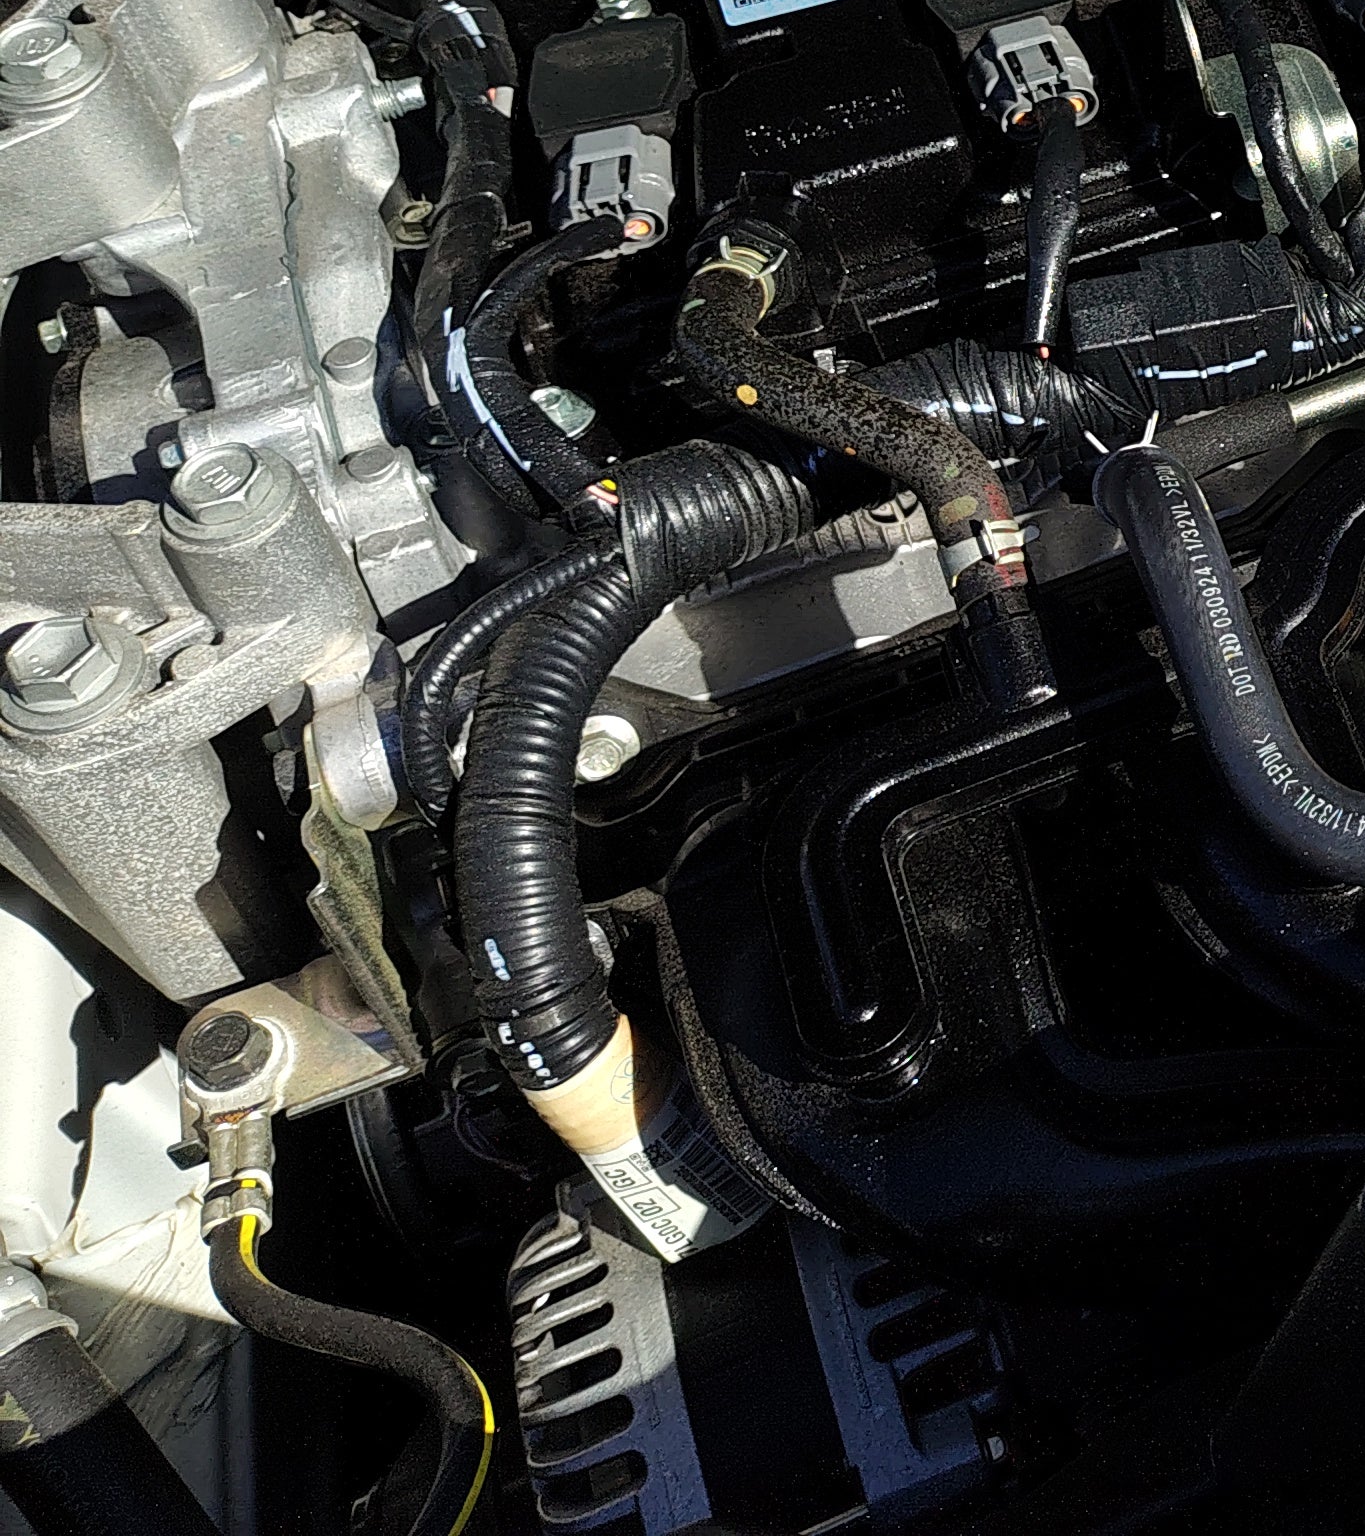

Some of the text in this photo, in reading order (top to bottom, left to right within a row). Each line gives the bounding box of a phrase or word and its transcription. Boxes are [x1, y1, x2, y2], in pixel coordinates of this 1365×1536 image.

[1194, 566, 1233, 629] 030924
[1228, 665, 1256, 697] DOT
[604, 1168, 636, 1189] GC
[632, 1197, 664, 1216] 02
